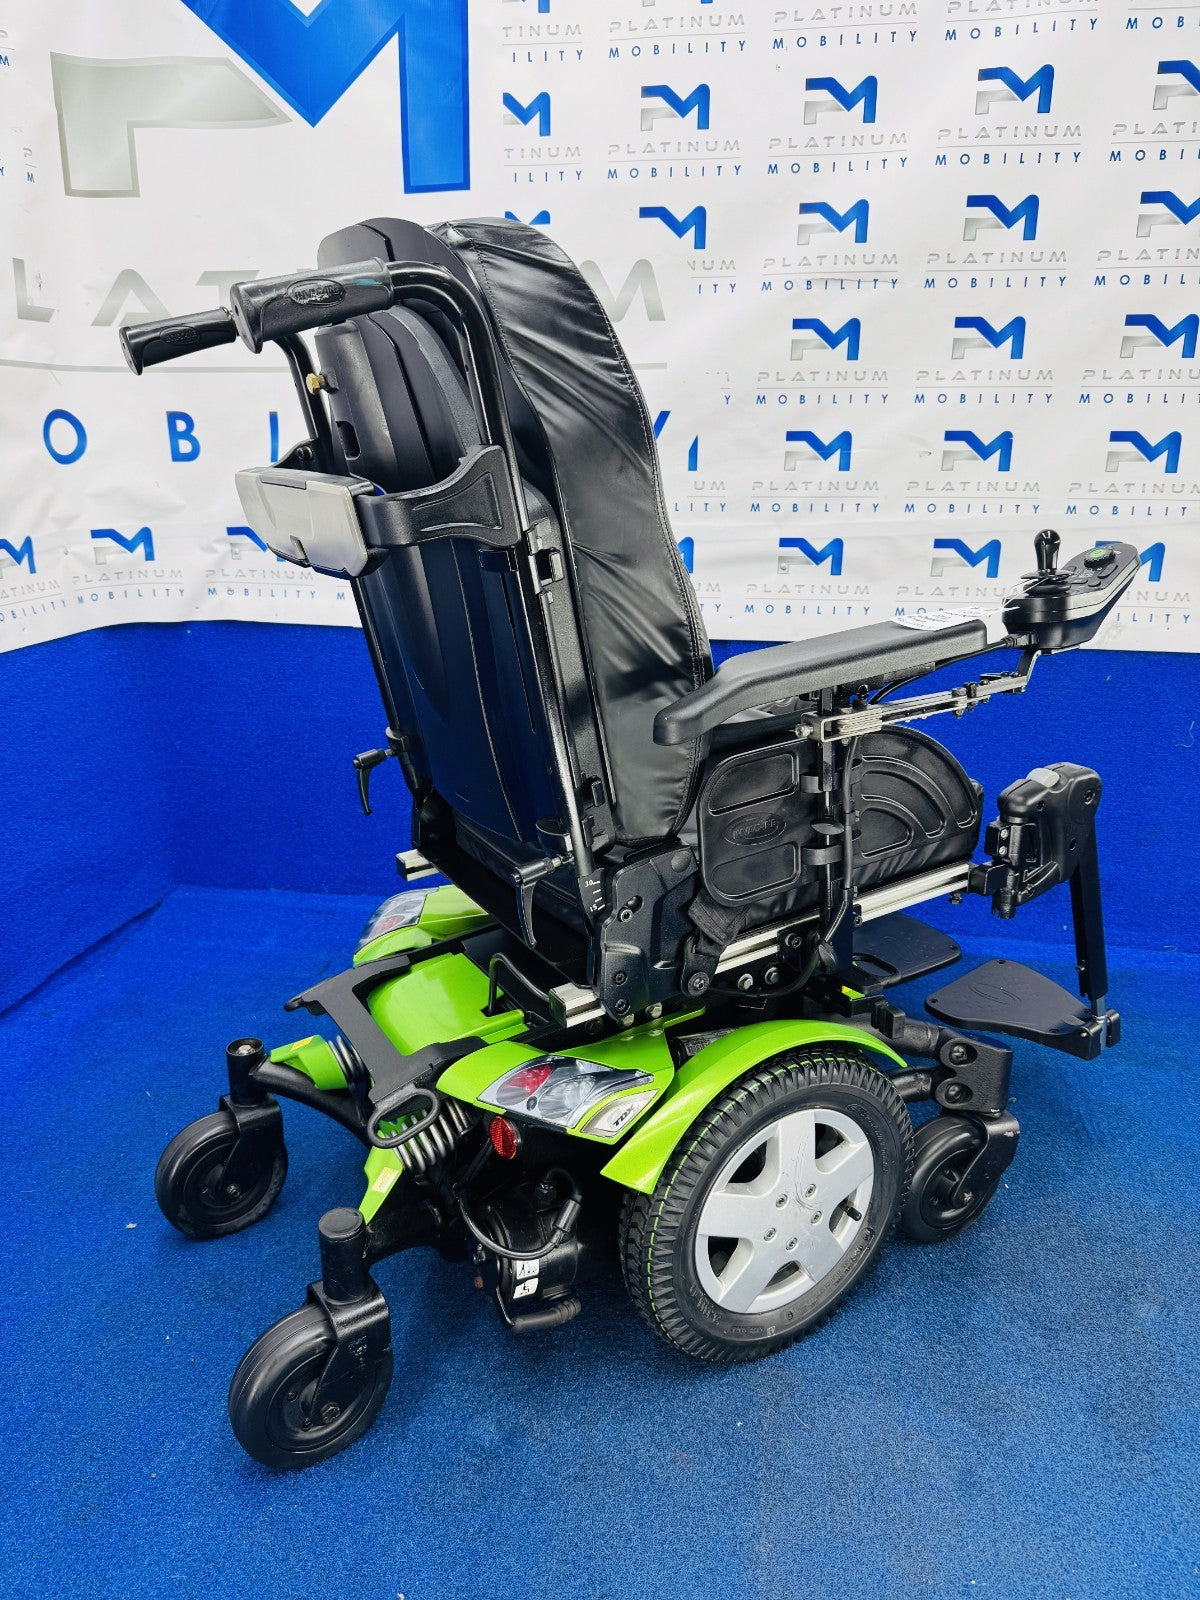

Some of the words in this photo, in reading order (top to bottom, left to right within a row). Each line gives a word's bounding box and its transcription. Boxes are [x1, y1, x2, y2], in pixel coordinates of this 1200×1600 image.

[774, 7, 917, 23] PLATINUM
[609, 14, 745, 33] PLATINUM
[944, 18, 1096, 41] MOBILITY
[772, 32, 916, 48] MOBILITY
[609, 39, 745, 58] MOBILITY
[938, 125, 1081, 140] PLATINUM
[768, 132, 907, 149] PLATINUM
[608, 140, 740, 155] PLATINUM
[935, 152, 1079, 166] MOBILITY
[608, 164, 741, 180] MOBILITY
[767, 157, 907, 175] MOBILITY
[764, 254, 898, 268] PLATINUM
[927, 251, 1066, 264] PLATINUM
[762, 277, 896, 292] MOBILITY
[923, 275, 1065, 288] MOBILITY
[1094, 274, 1200, 286] MOBIL
[758, 371, 888, 382] PLATINUM
[917, 370, 1053, 380] PLATINUM
[755, 394, 887, 405] MOBILITY
[914, 392, 1051, 404] MOBILITY
[1079, 393, 1200, 404] MOBILI
[752, 481, 879, 491] PLATINUM
[907, 481, 1040, 492] PLATINUM
[749, 502, 878, 512] MOBILITY
[904, 503, 1038, 512] MOBILITY
[72, 569, 183, 586] PLATINUM
[207, 587, 316, 600] MOBILITY
[747, 584, 869, 594] PLATINUM
[744, 604, 869, 616] MOBILITY
[612, 1104, 635, 1128] TDX
